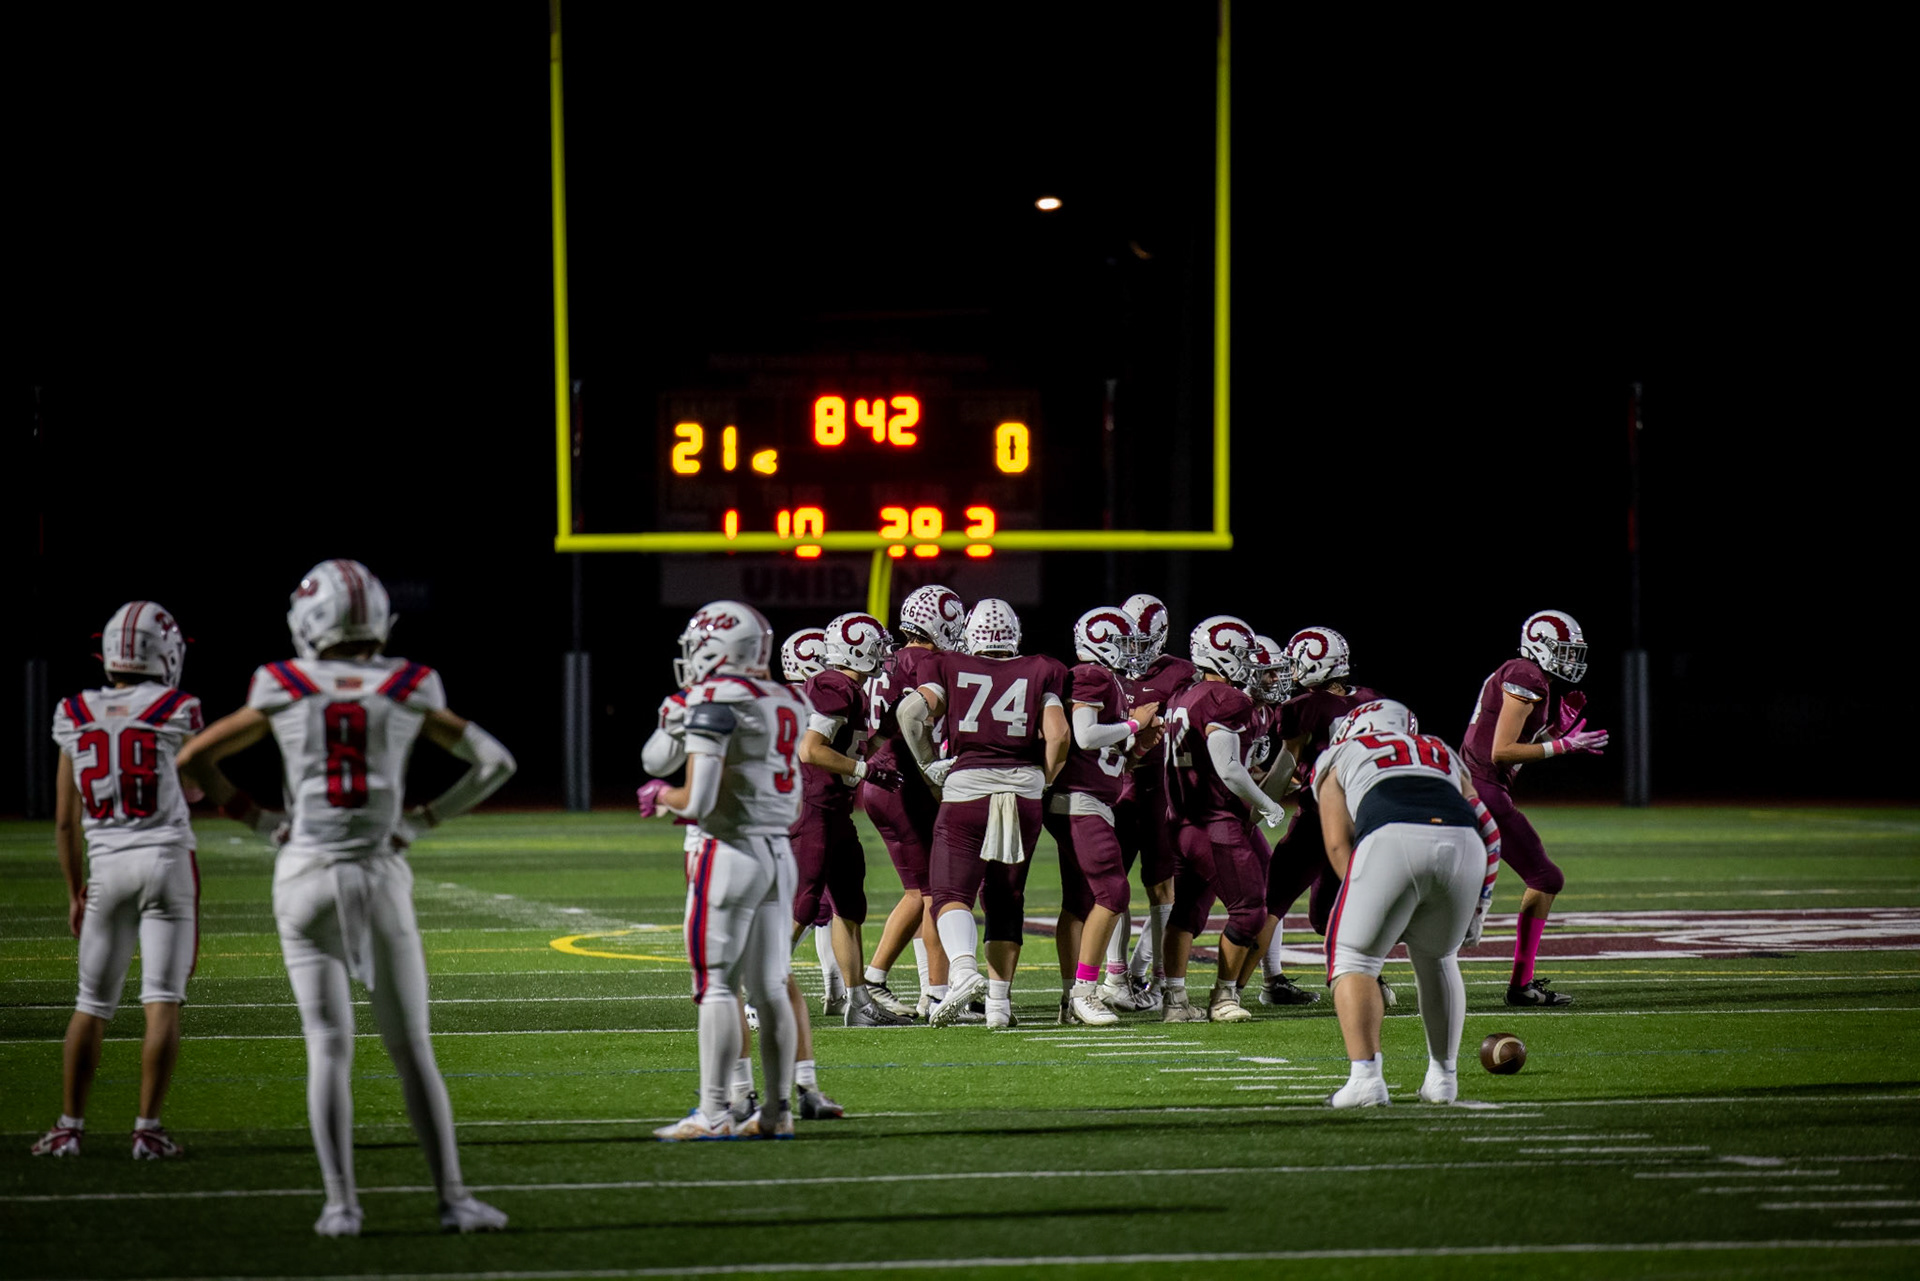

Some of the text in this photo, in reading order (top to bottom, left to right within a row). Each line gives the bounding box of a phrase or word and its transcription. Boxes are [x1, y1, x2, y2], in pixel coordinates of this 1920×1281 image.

[671, 421, 737, 475] 21
[994, 421, 1031, 474] 0
[987, 630, 1001, 642] 74
[957, 671, 1029, 737] 74
[78, 729, 158, 819] 28
[324, 702, 370, 808] 8
[774, 706, 798, 794] 9
